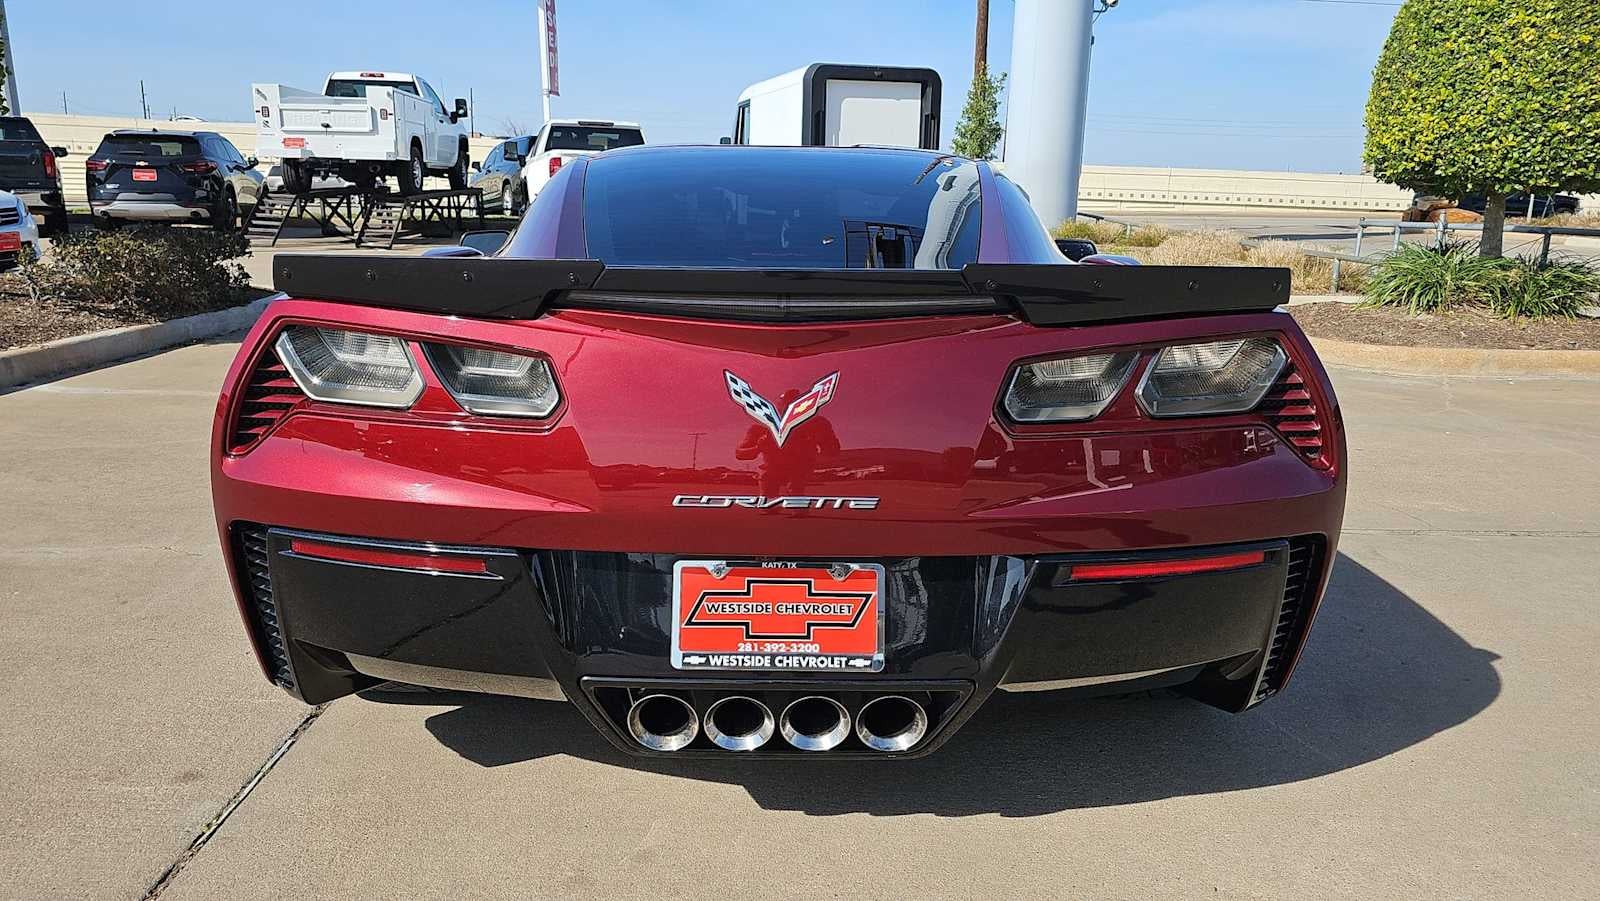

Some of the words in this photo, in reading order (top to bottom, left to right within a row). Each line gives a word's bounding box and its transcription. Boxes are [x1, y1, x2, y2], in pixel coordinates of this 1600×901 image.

[673, 495, 880, 509] CORVETTE
[705, 602, 771, 614] WESTSIDE
[776, 602, 854, 615] CHEVROLET
[737, 642, 820, 652] 281-392-3200
[708, 655, 774, 667] WESTSIDE
[775, 655, 848, 668] CHEVROLET
